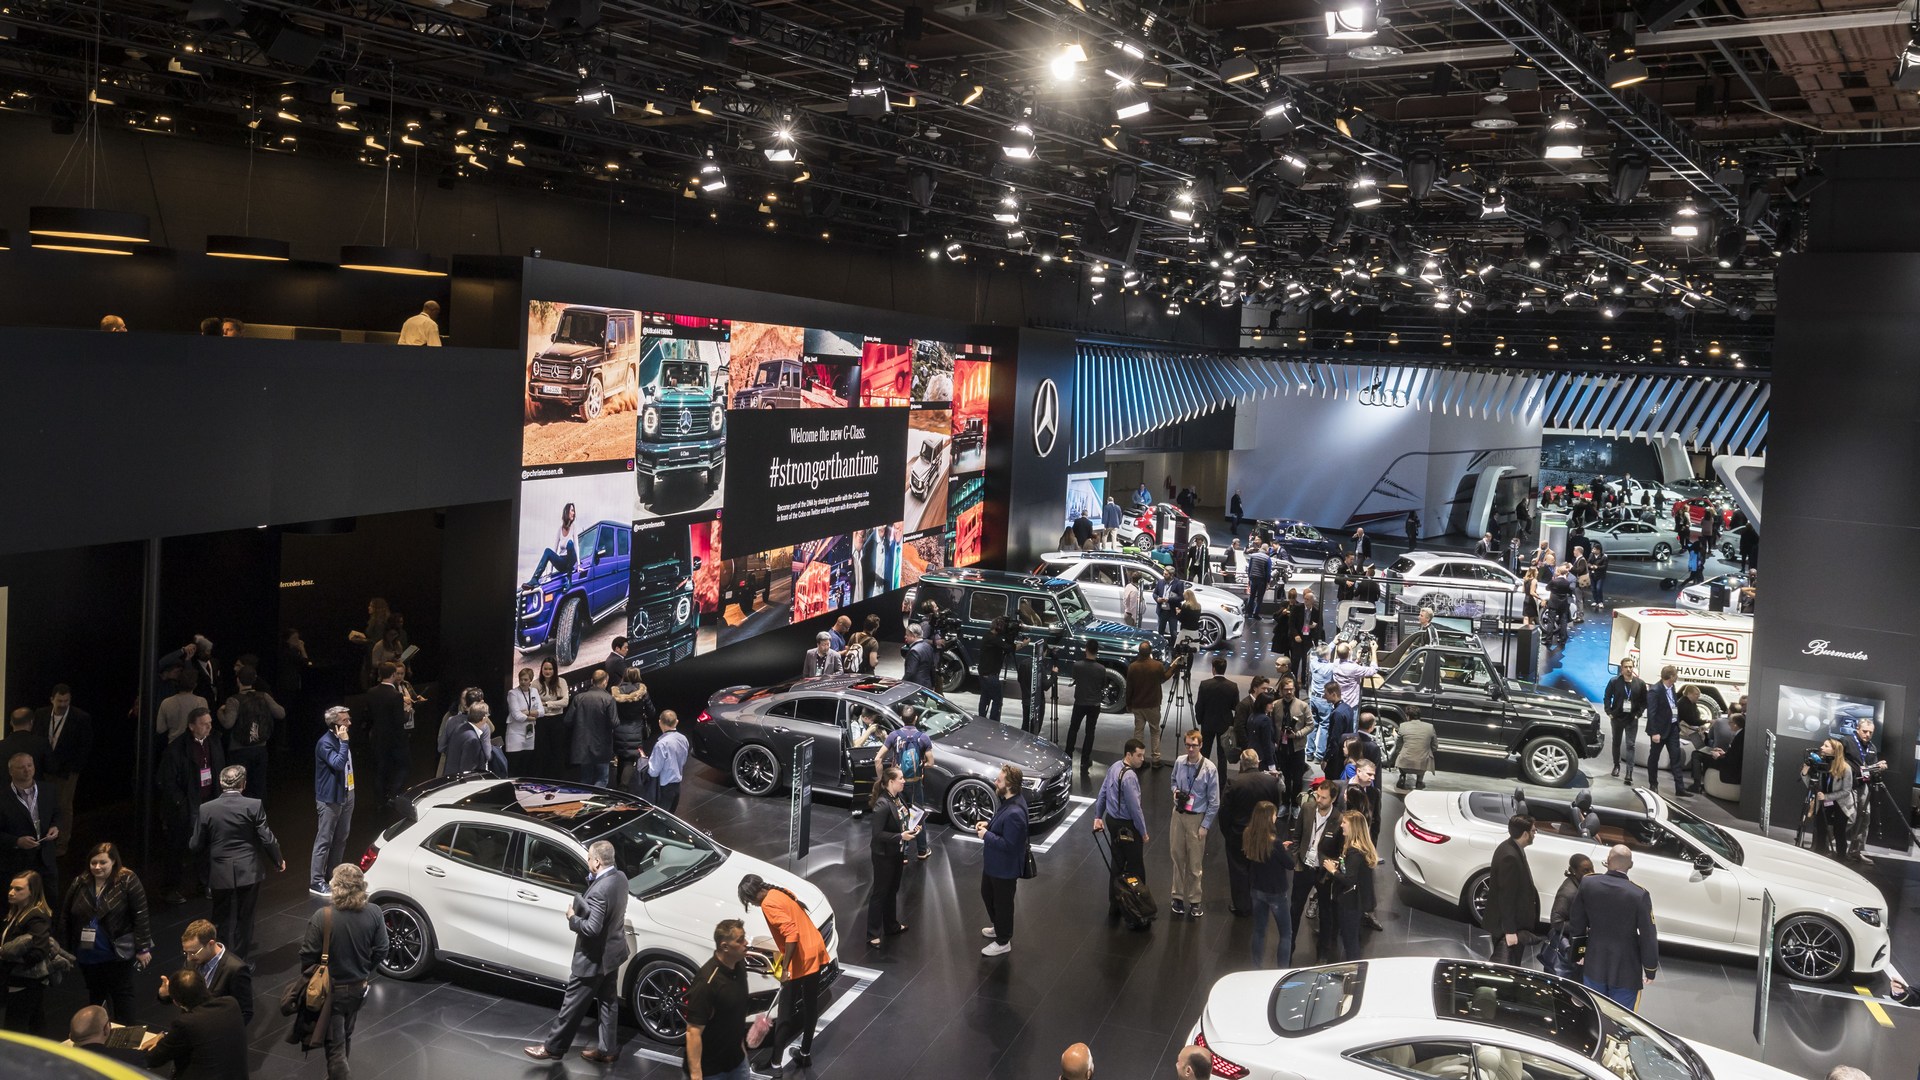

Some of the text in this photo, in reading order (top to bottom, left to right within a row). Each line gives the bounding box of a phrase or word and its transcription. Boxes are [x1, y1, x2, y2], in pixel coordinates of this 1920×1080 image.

[790, 427, 818, 443] Welcome
[819, 426, 829, 442] the
[830, 429, 843, 441] new
[769, 449, 879, 490] #strongerthantime
[777, 504, 790, 512] Become
[780, 513, 788, 521] front
[1434, 593, 1466, 606] Grace
[1680, 639, 1735, 655] TEXACO
[1801, 639, 1868, 660] Burmester
[1676, 666, 1731, 679] HAVOLINE
